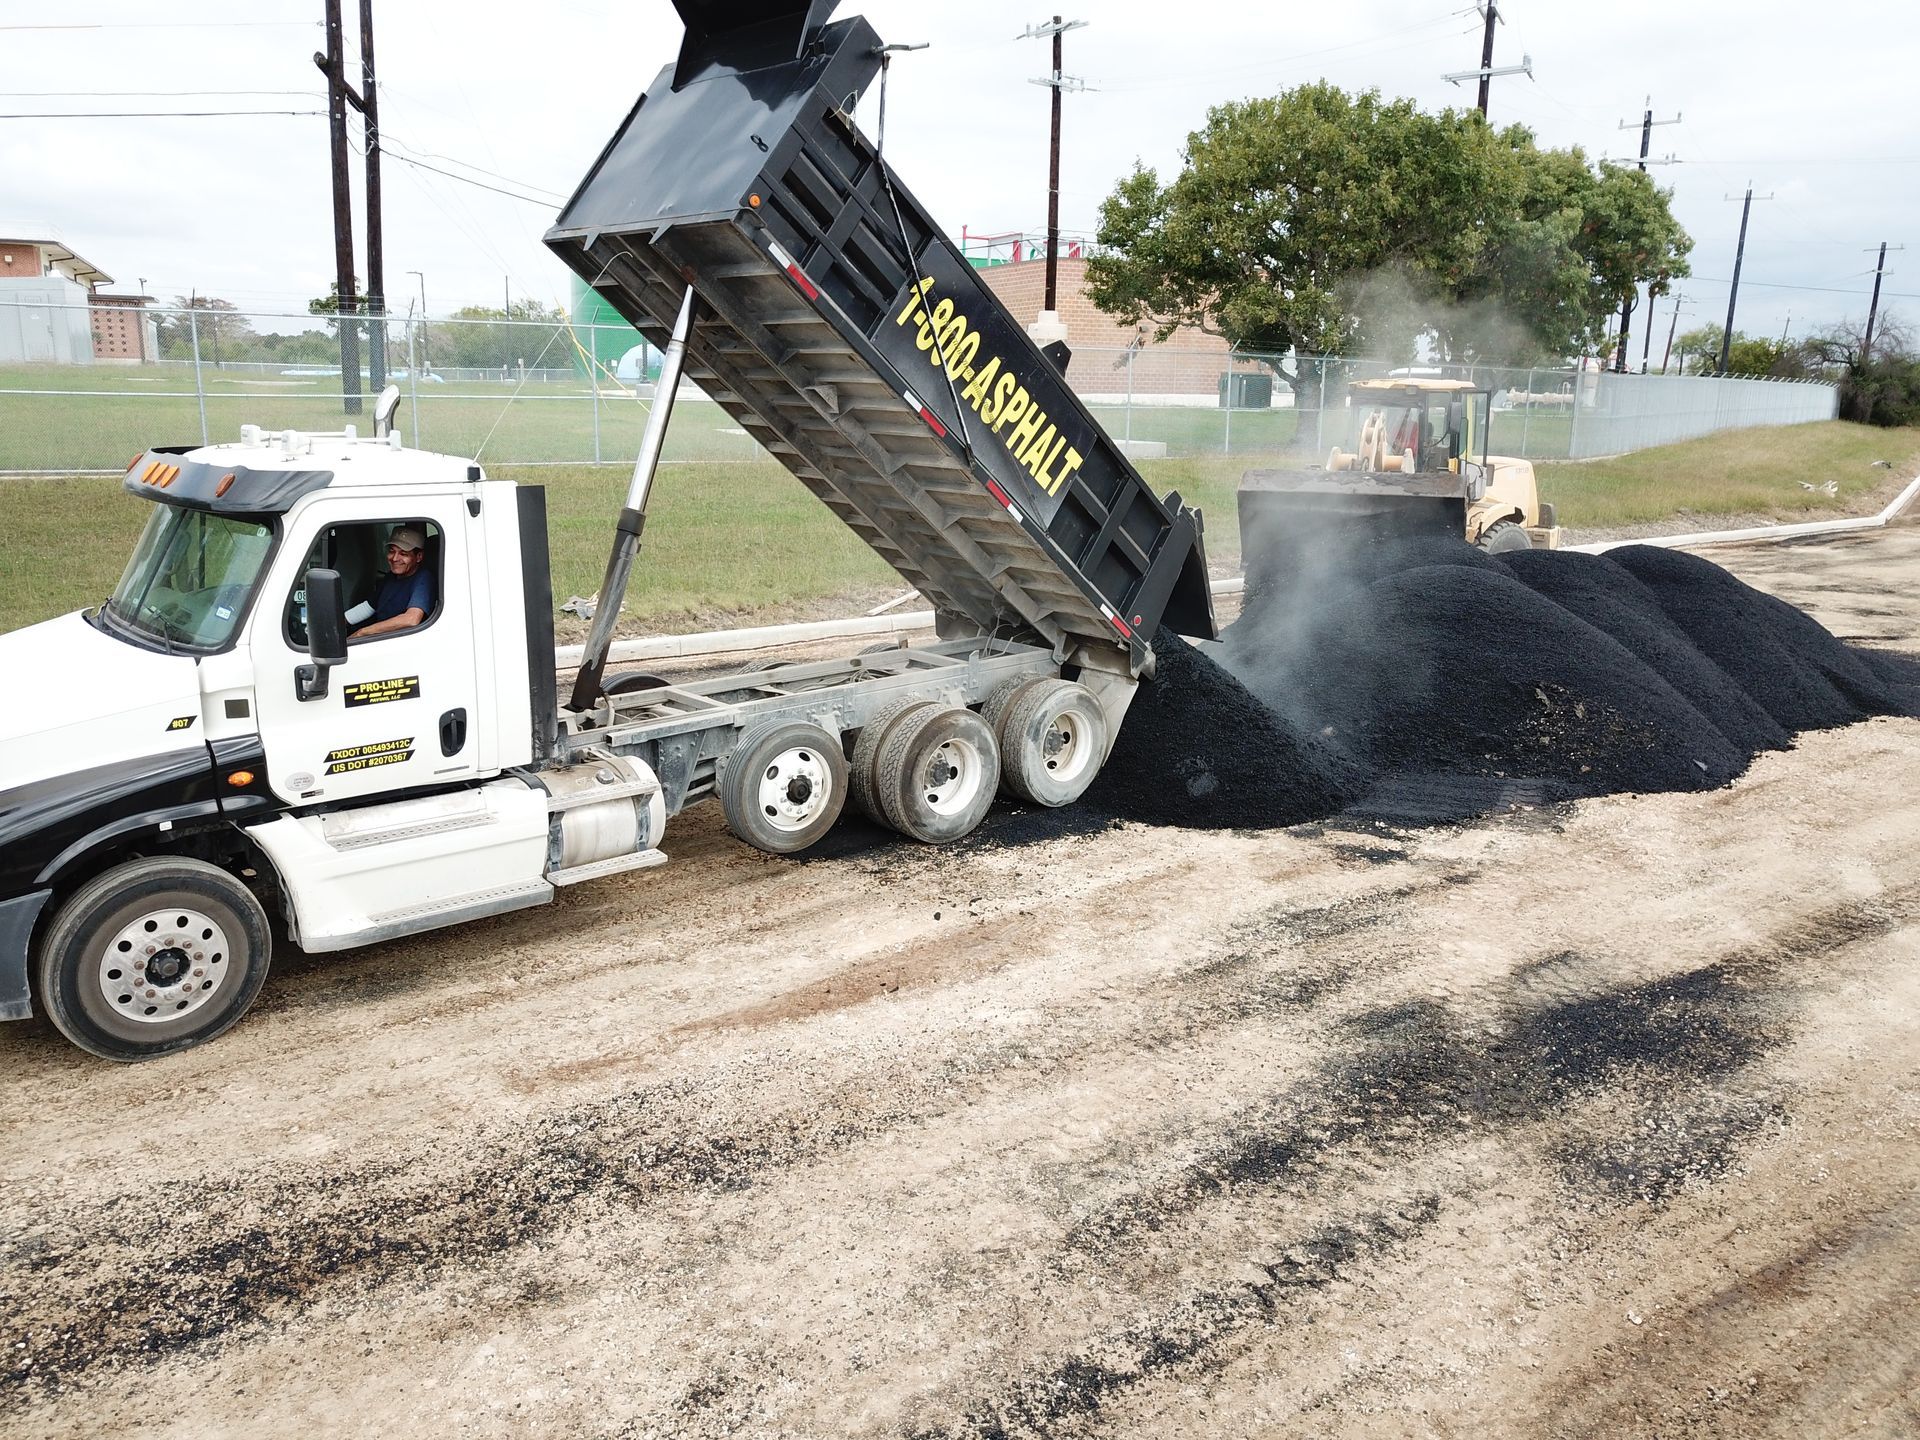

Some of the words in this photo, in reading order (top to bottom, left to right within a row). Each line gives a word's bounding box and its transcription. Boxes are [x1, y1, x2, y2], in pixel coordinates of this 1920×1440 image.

[896, 276, 1084, 498] 1-800-ASPHALT
[360, 679, 404, 693] PRO-LINE
[172, 719, 189, 728] #07
[330, 748, 360, 760] TXDOT
[362, 740, 410, 754] 005493412C
[332, 764, 346, 772] US
[348, 760, 366, 770] DOT
[368, 752, 407, 766] #2070367
